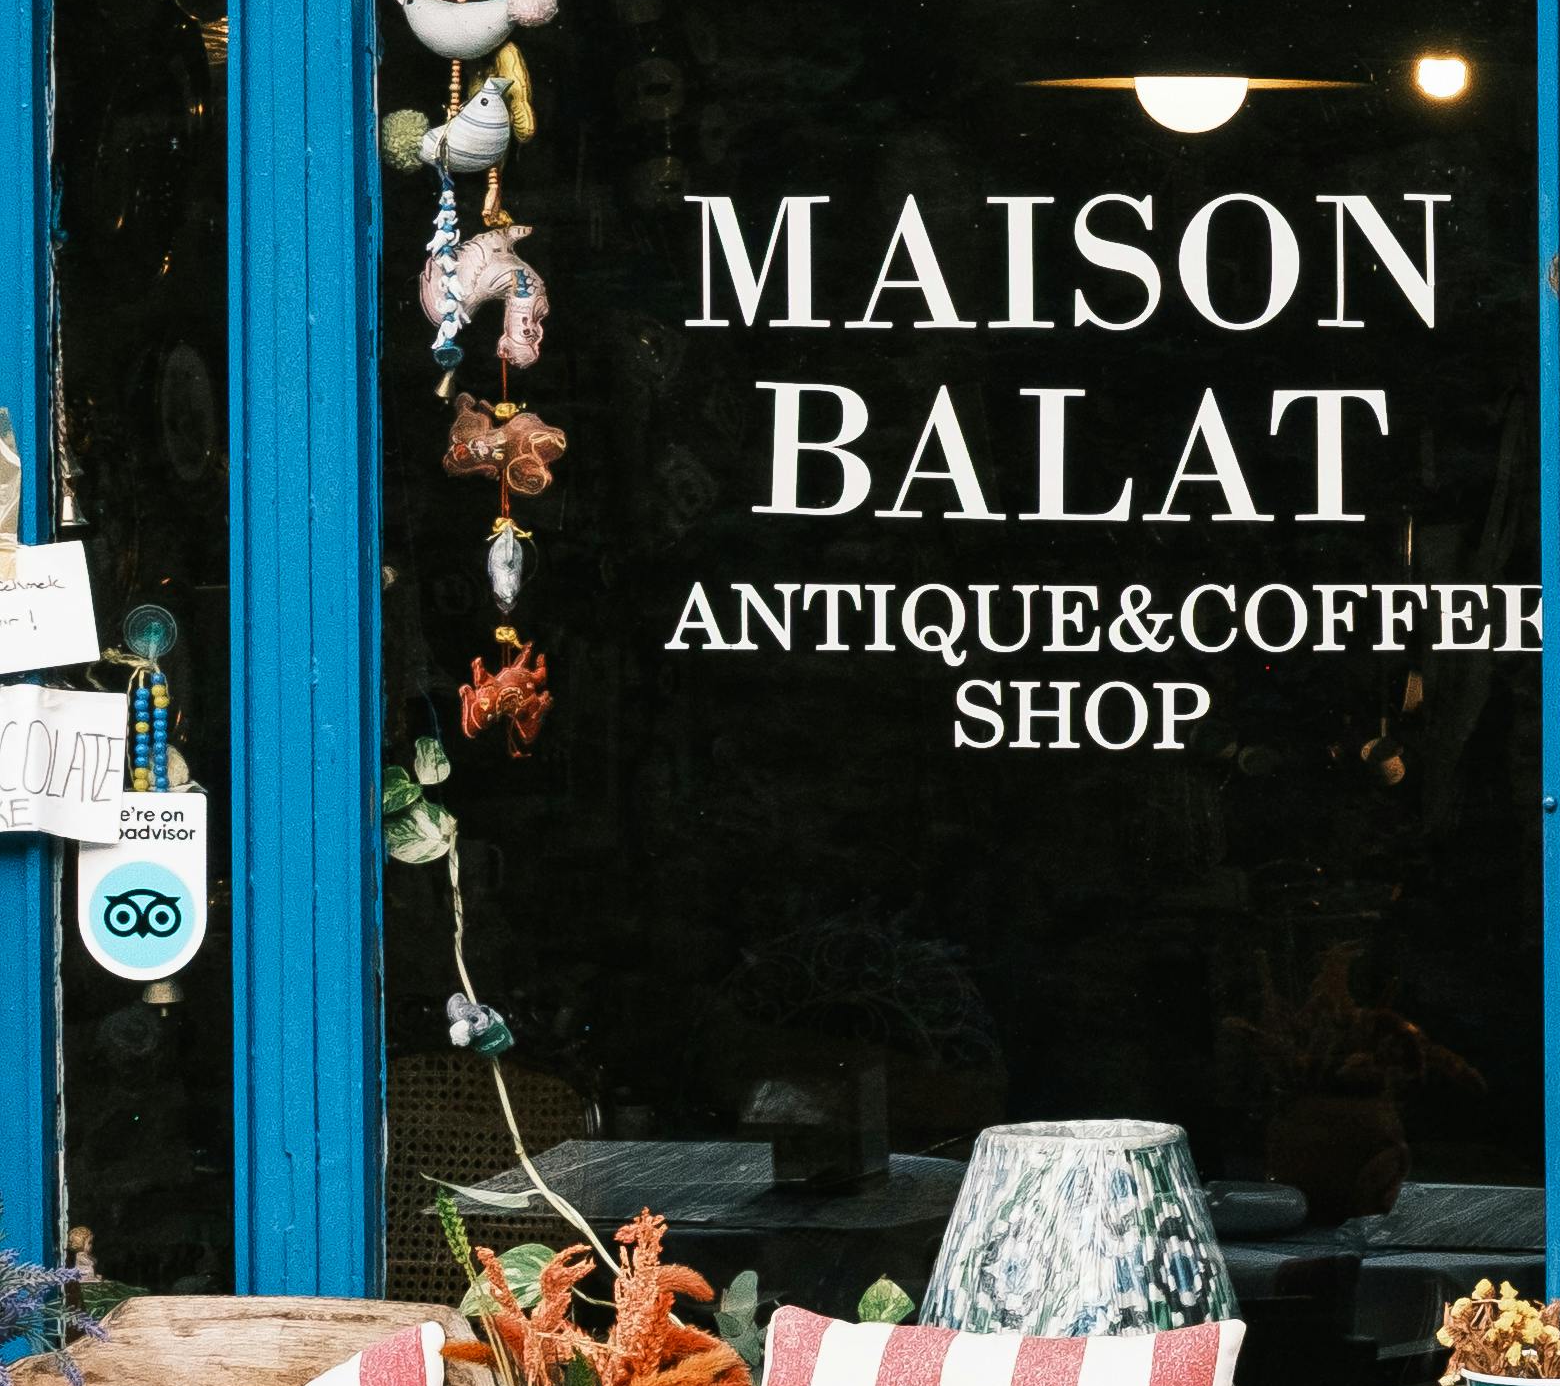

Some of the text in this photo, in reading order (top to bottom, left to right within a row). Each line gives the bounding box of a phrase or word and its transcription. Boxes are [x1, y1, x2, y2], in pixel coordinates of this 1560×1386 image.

[683, 192, 1453, 331] MAISON
[751, 380, 1390, 523] BALAT
[953, 679, 1212, 752] SHOP
[120, 806, 185, 823] e're on
